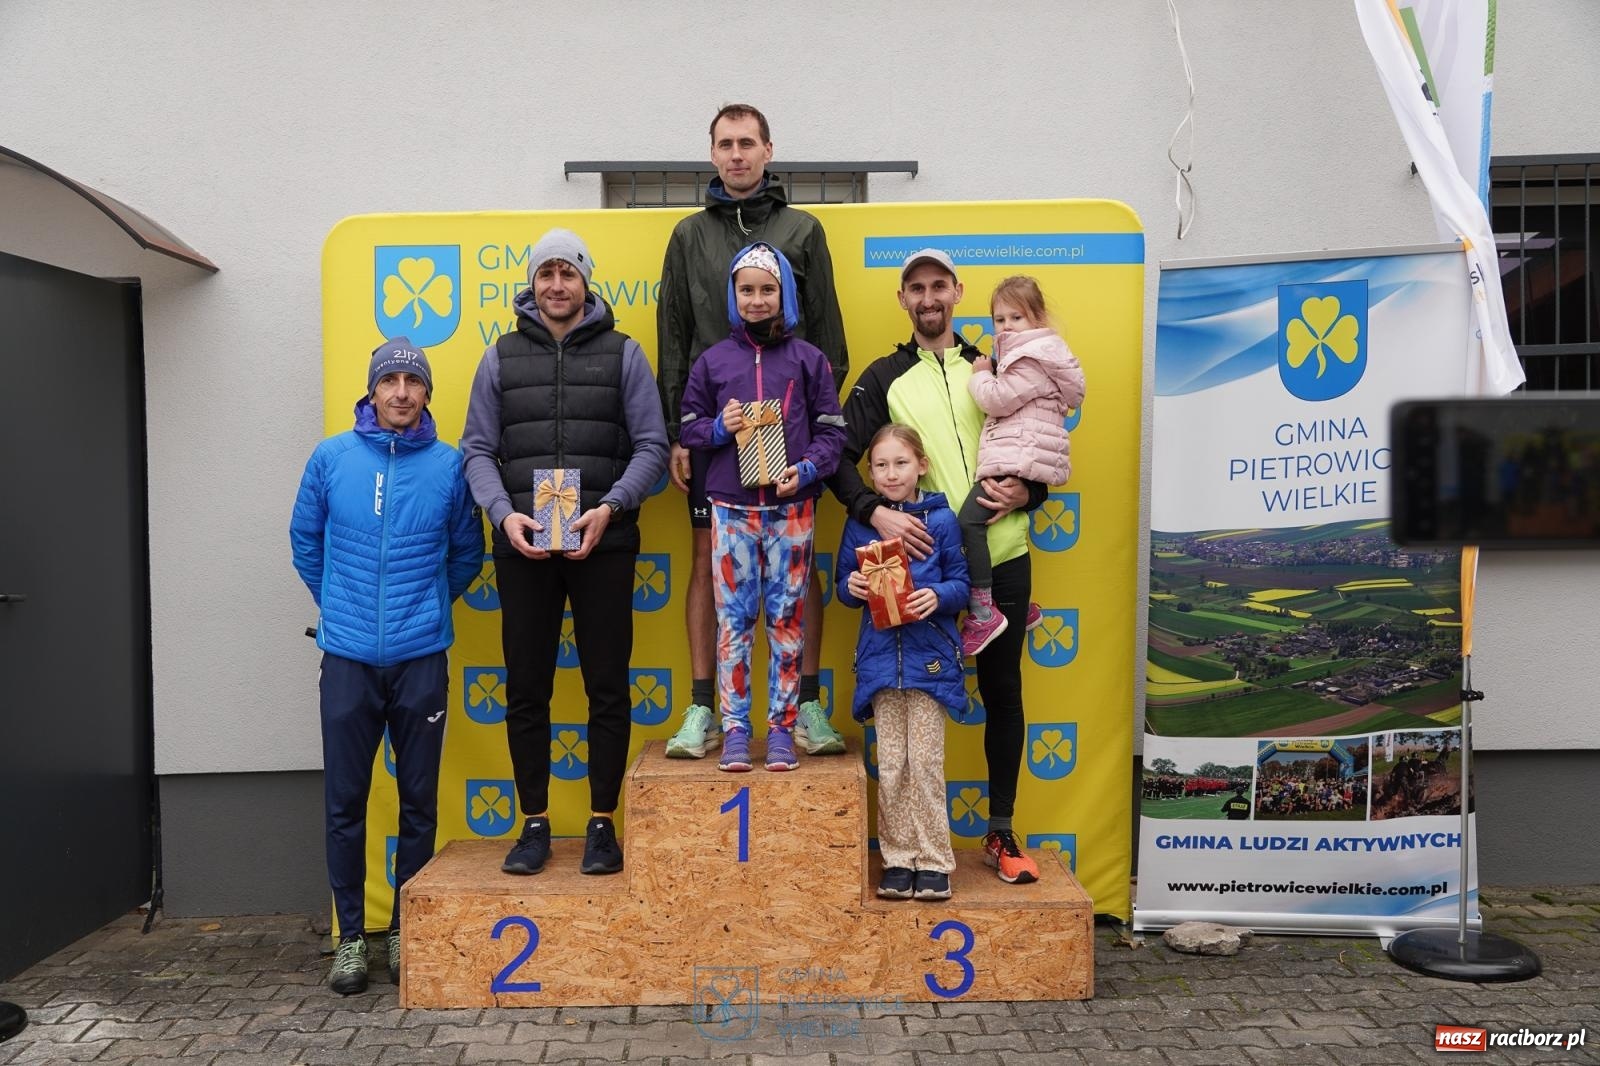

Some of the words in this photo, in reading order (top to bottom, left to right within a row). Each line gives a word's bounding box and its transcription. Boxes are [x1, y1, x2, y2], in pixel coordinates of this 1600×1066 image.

[869, 243, 1084, 260] wwwowicewielkie.com.pl
[1275, 416, 1368, 446] GMINA
[1229, 447, 1392, 481] PIETROWIC
[1261, 480, 1377, 512] WIELKIE
[719, 786, 751, 863] 1
[1155, 834, 1233, 850] GMINA
[1239, 835, 1308, 851] LUDZI
[1315, 832, 1462, 852] AKTYWNYCH
[1167, 880, 1448, 897] www.pietrowicewielkie.com.pl
[489, 915, 541, 994] 2
[924, 919, 976, 999] 3
